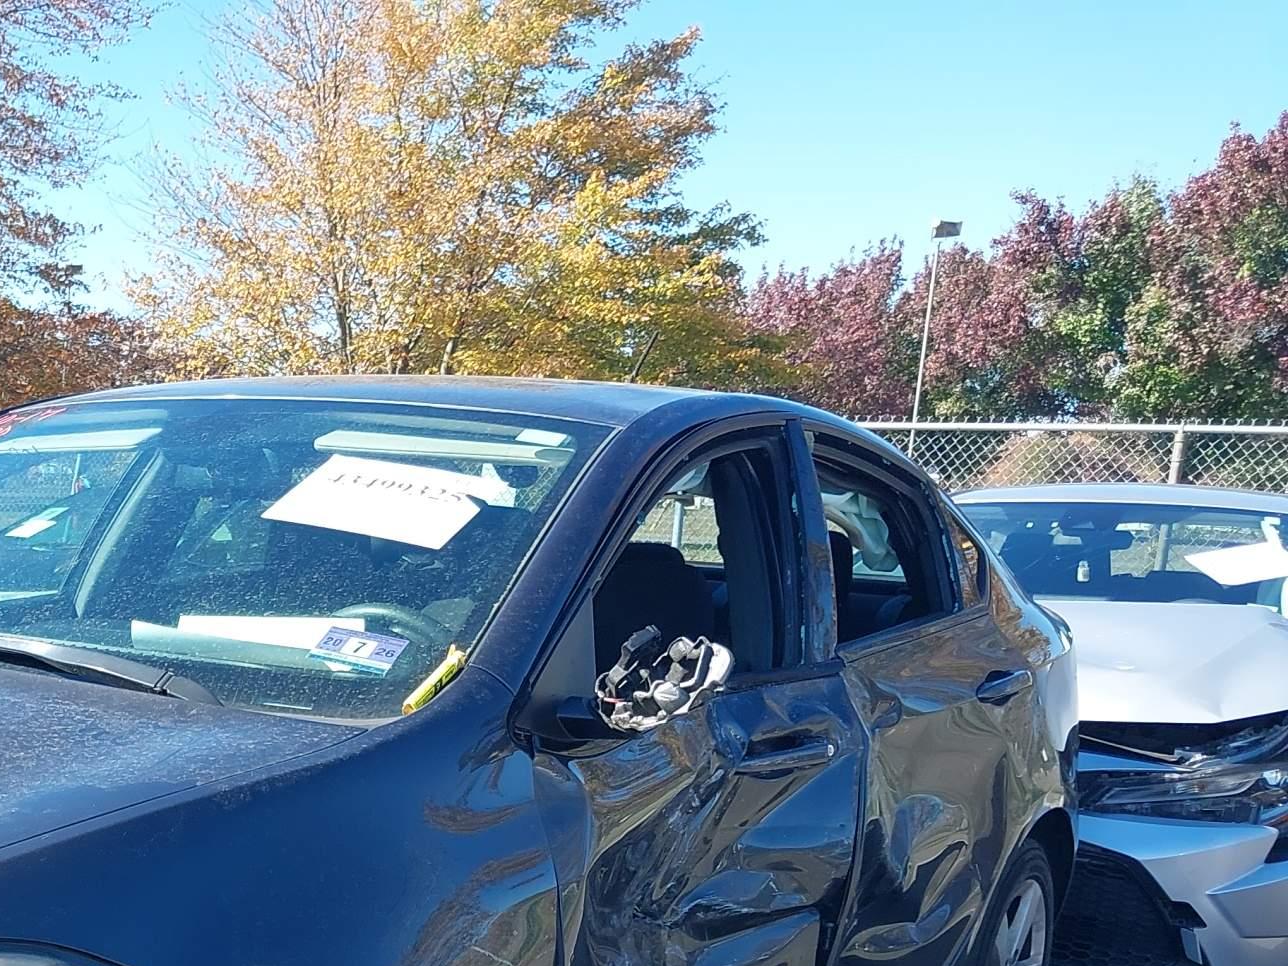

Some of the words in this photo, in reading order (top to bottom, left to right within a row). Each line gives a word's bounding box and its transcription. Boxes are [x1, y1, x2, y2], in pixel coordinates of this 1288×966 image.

[323, 637, 343, 647] 20
[353, 641, 367, 654] 7
[375, 648, 396, 658] 26
